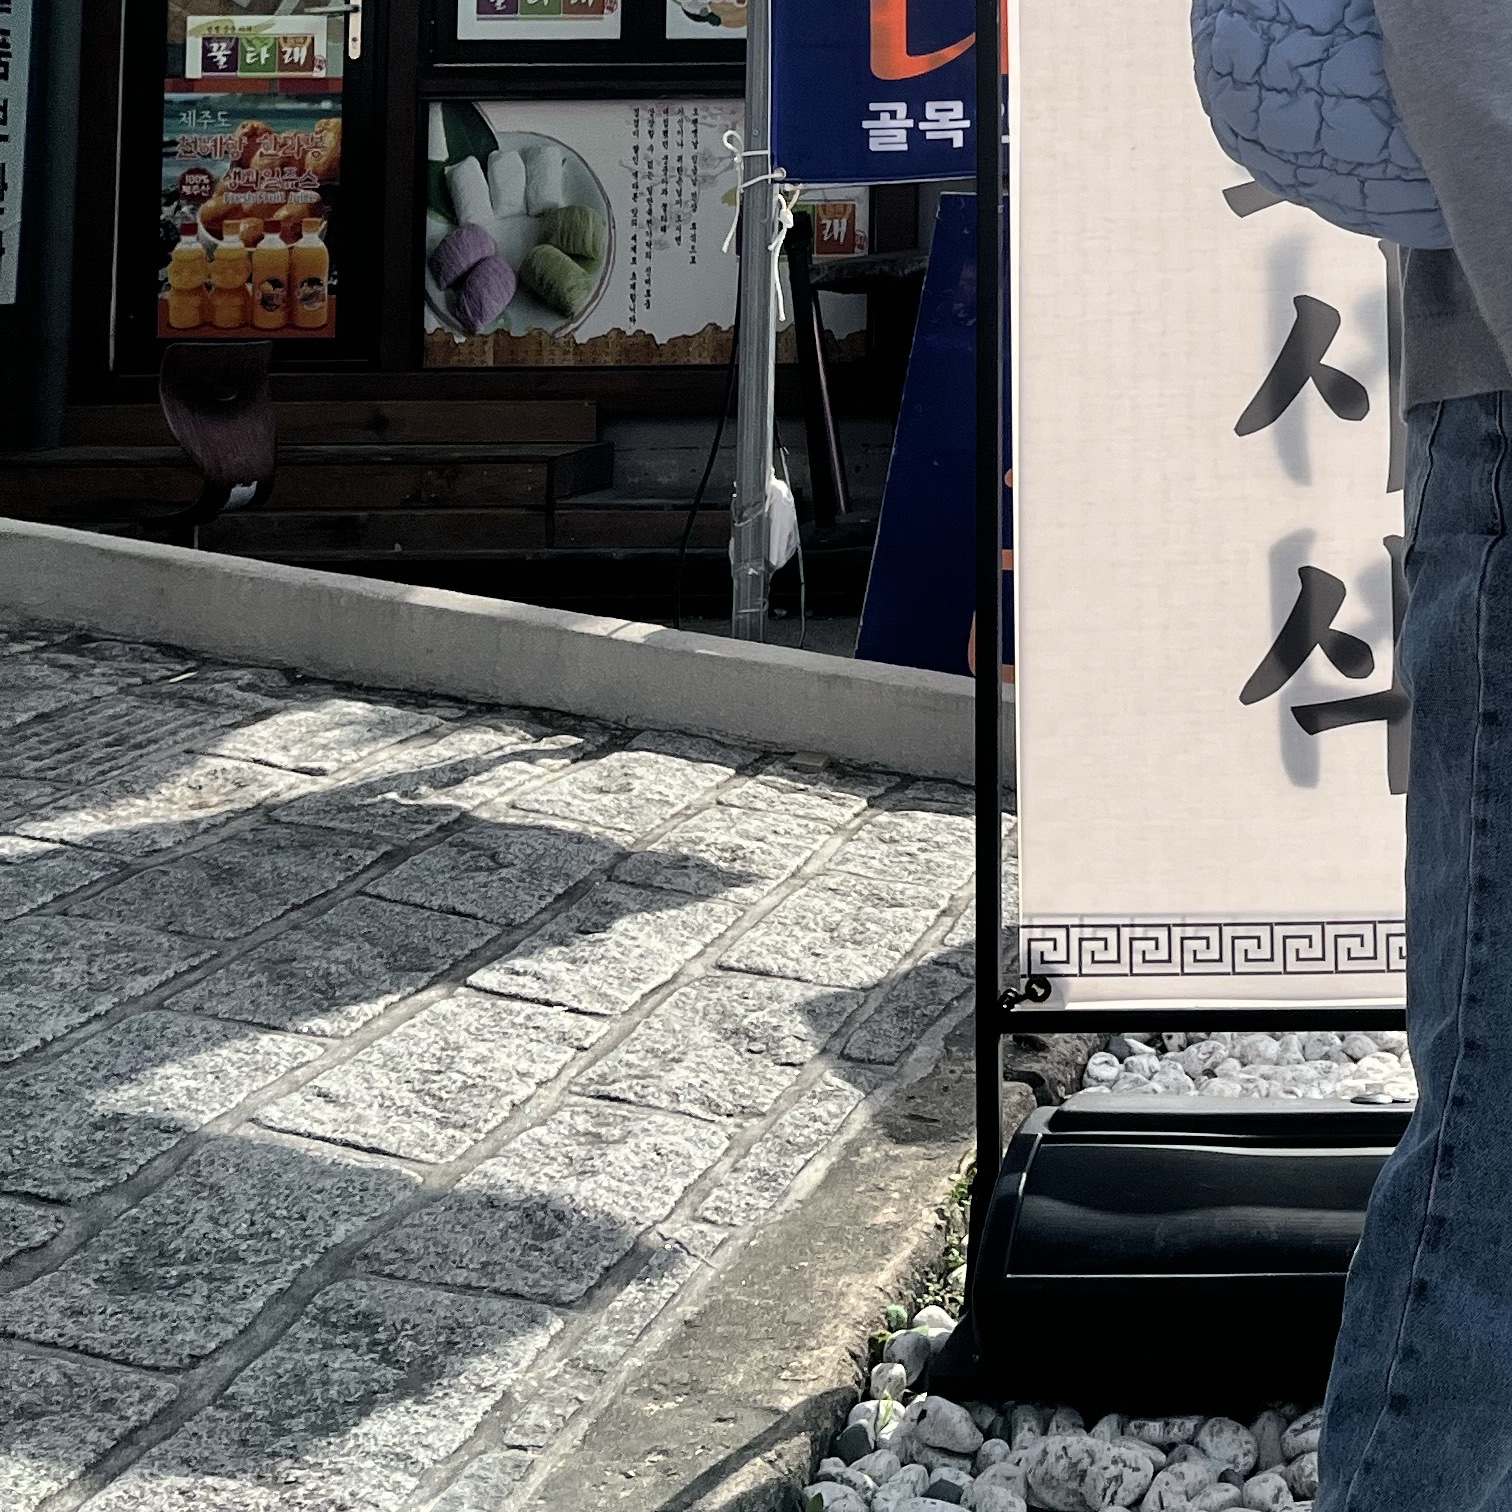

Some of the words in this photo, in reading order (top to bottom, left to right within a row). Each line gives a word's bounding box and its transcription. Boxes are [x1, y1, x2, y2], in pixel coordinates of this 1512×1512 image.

[206, 41, 308, 69] 꿀타래
[179, 109, 232, 129] 제주도
[862, 99, 1008, 153] 골목
